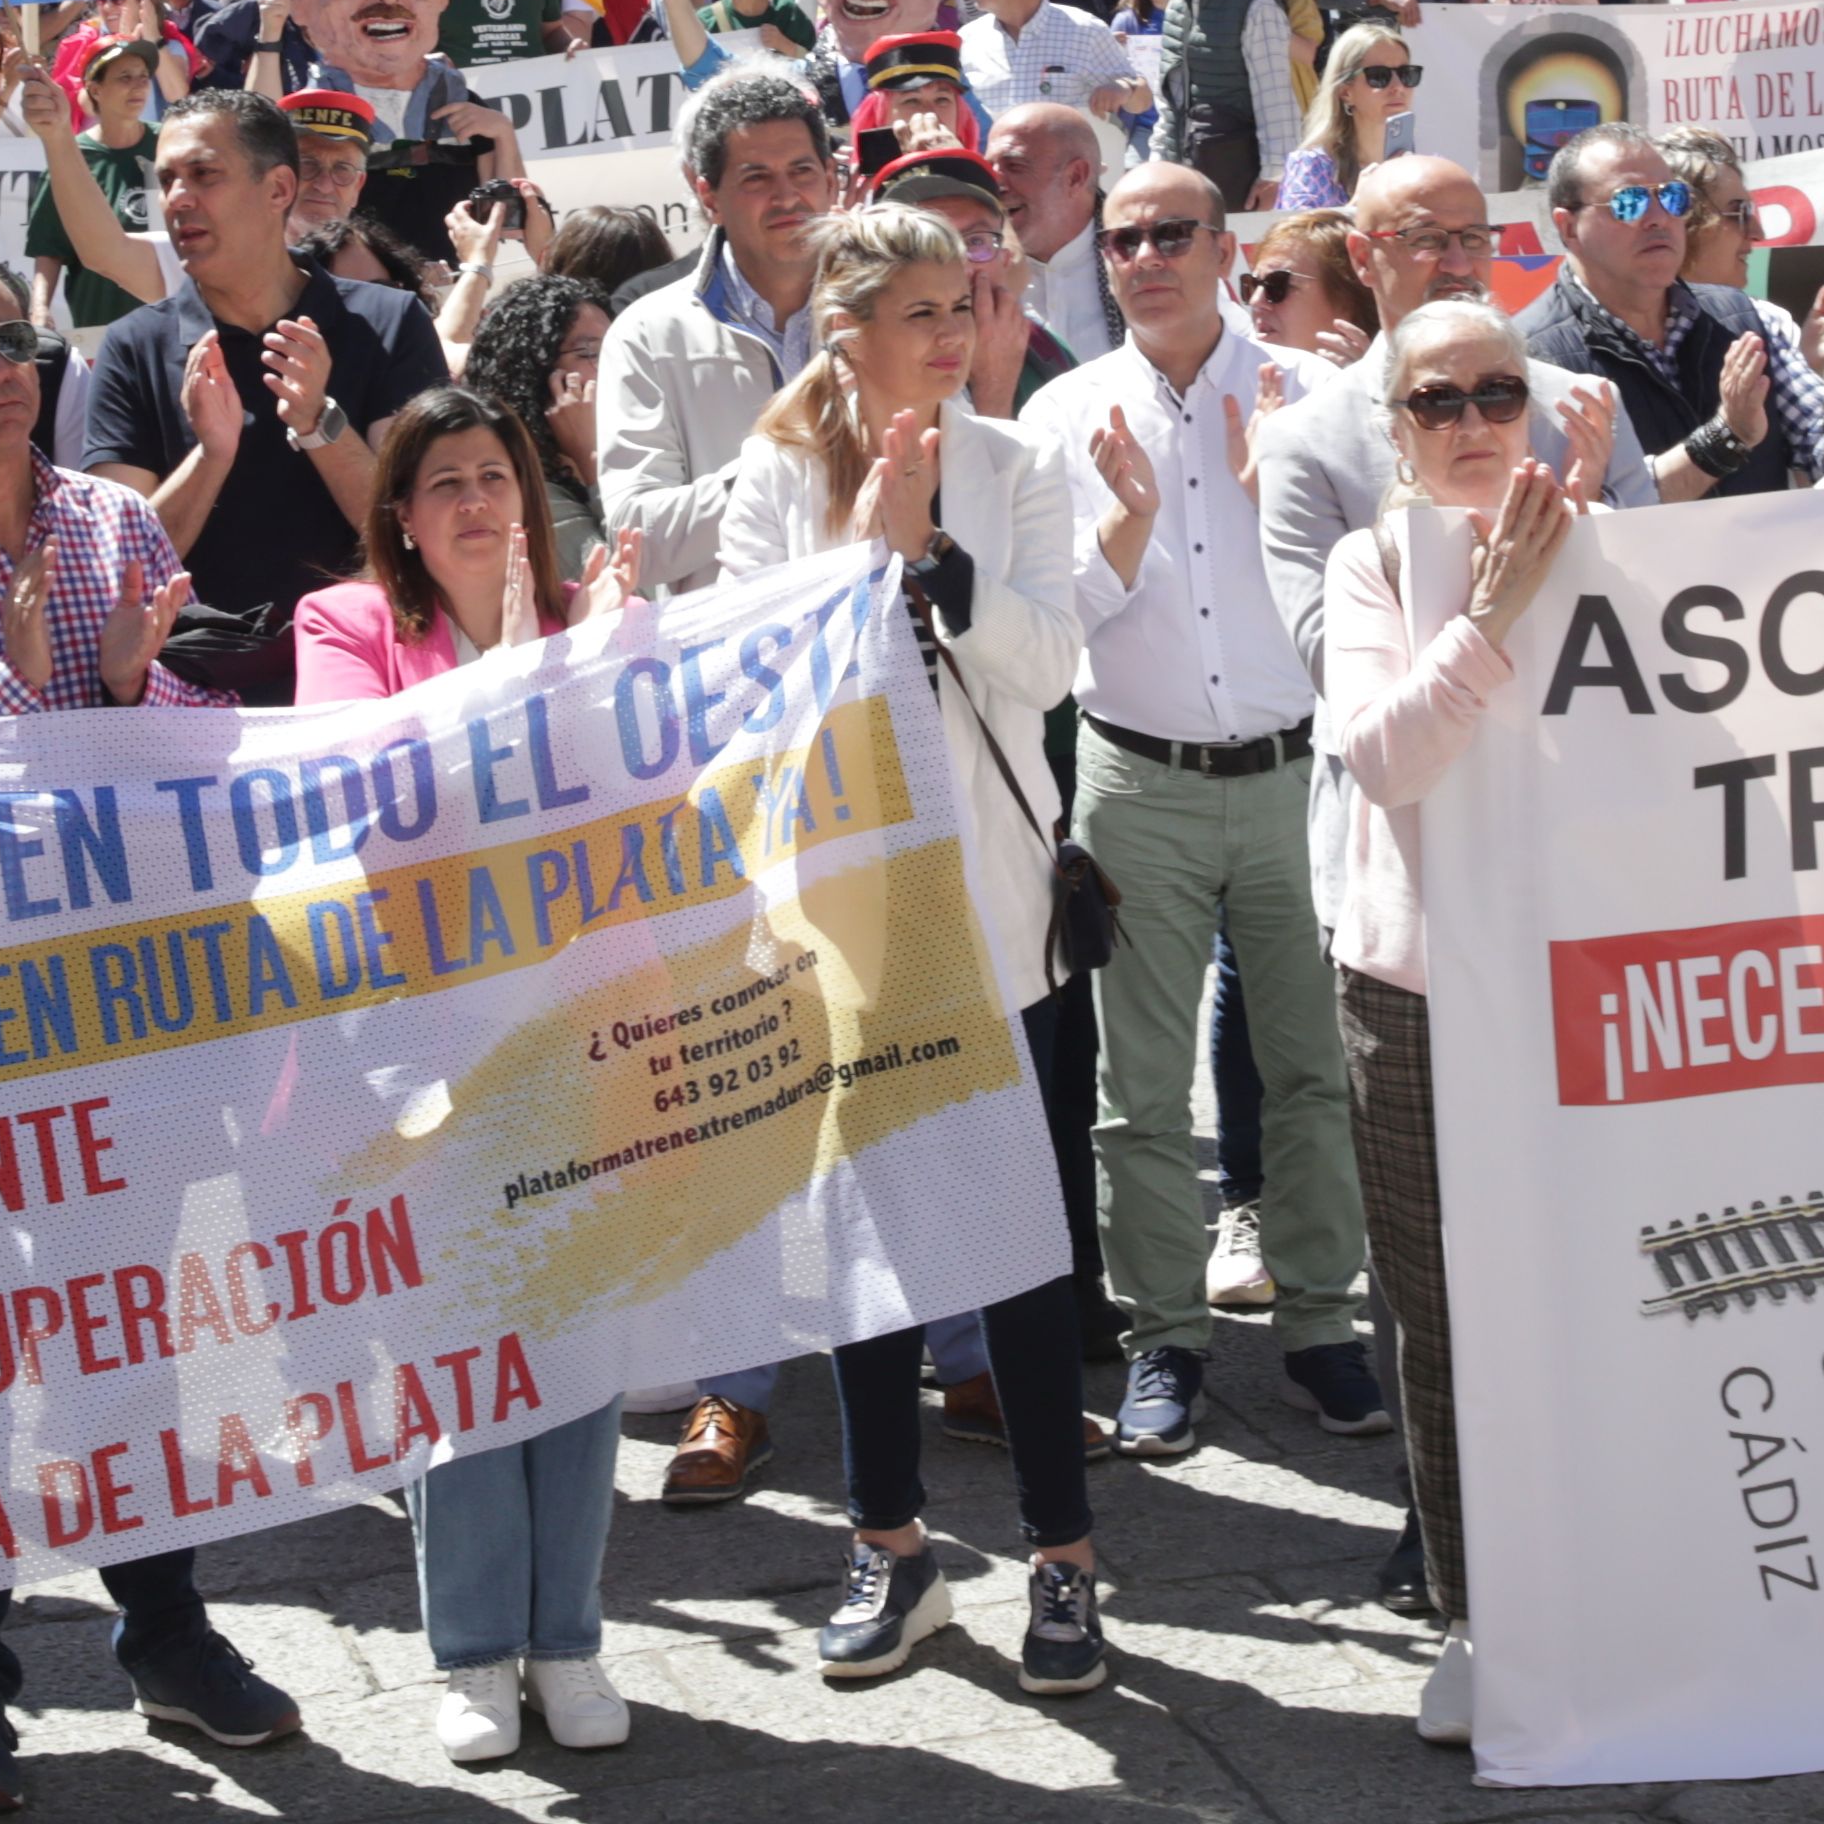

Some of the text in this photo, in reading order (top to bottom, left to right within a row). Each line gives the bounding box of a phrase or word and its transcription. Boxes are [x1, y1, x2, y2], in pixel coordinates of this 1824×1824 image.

[480, 71, 686, 151] PLAT
[1663, 76, 1747, 124] RUTA
[1754, 71, 1796, 120] DE
[155, 737, 438, 893] TODO
[467, 693, 590, 825] EL
[87, 916, 297, 1046] RUTA
[306, 889, 407, 1000] DE
[417, 865, 516, 976] LA
[526, 785, 748, 949] PLATA
[795, 948, 820, 975] en
[503, 1034, 961, 1209] plataformatrenextremadura@gmail.com
[647, 1054, 673, 1077] tu
[653, 1038, 803, 1113] 643 92 03 92
[36, 1441, 145, 1549] DE
[158, 1411, 275, 1517] LA
[283, 1329, 543, 1485] PLATA
[1719, 1366, 1820, 1602] CÁDIZ
